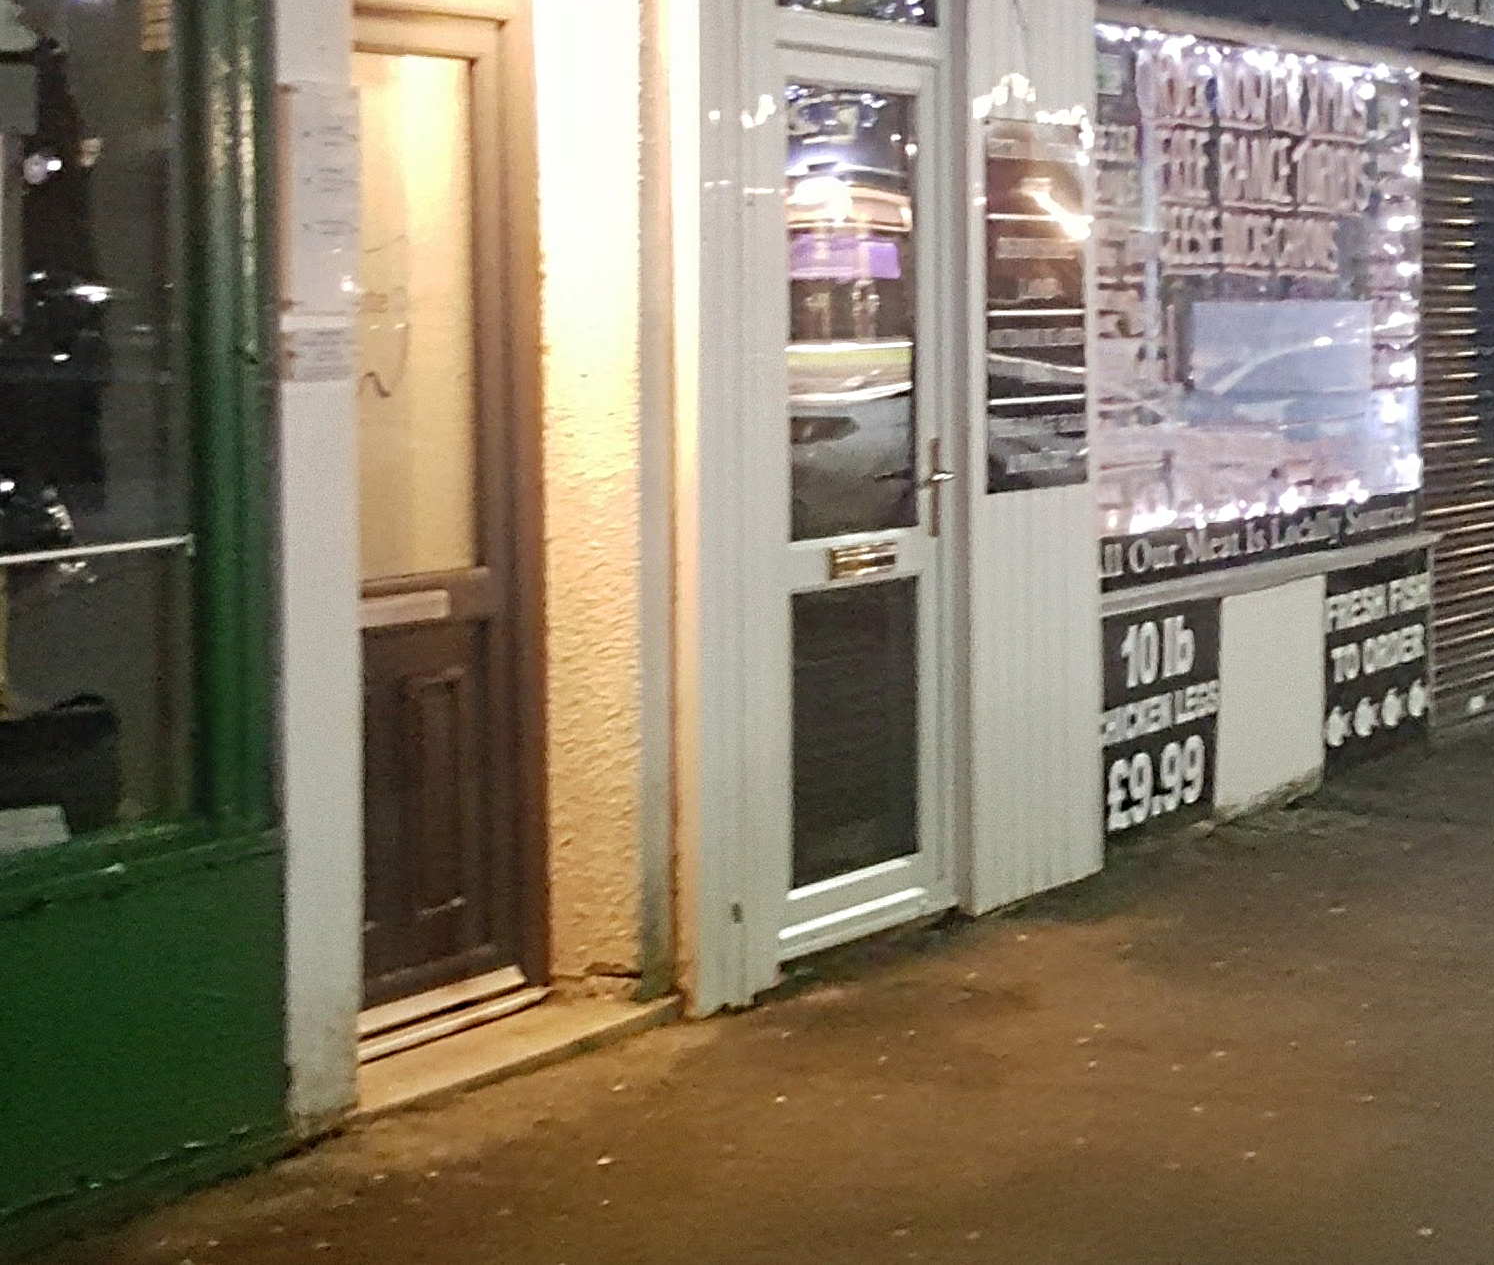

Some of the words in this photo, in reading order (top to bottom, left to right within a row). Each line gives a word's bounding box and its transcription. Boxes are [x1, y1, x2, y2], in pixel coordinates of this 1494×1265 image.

[1098, 541, 1124, 577] ll
[1128, 536, 1181, 573] Our
[1121, 621, 1160, 689] 10
[1162, 614, 1196, 678] lb
[1331, 642, 1361, 684] TO
[1107, 734, 1206, 832] £9.99
